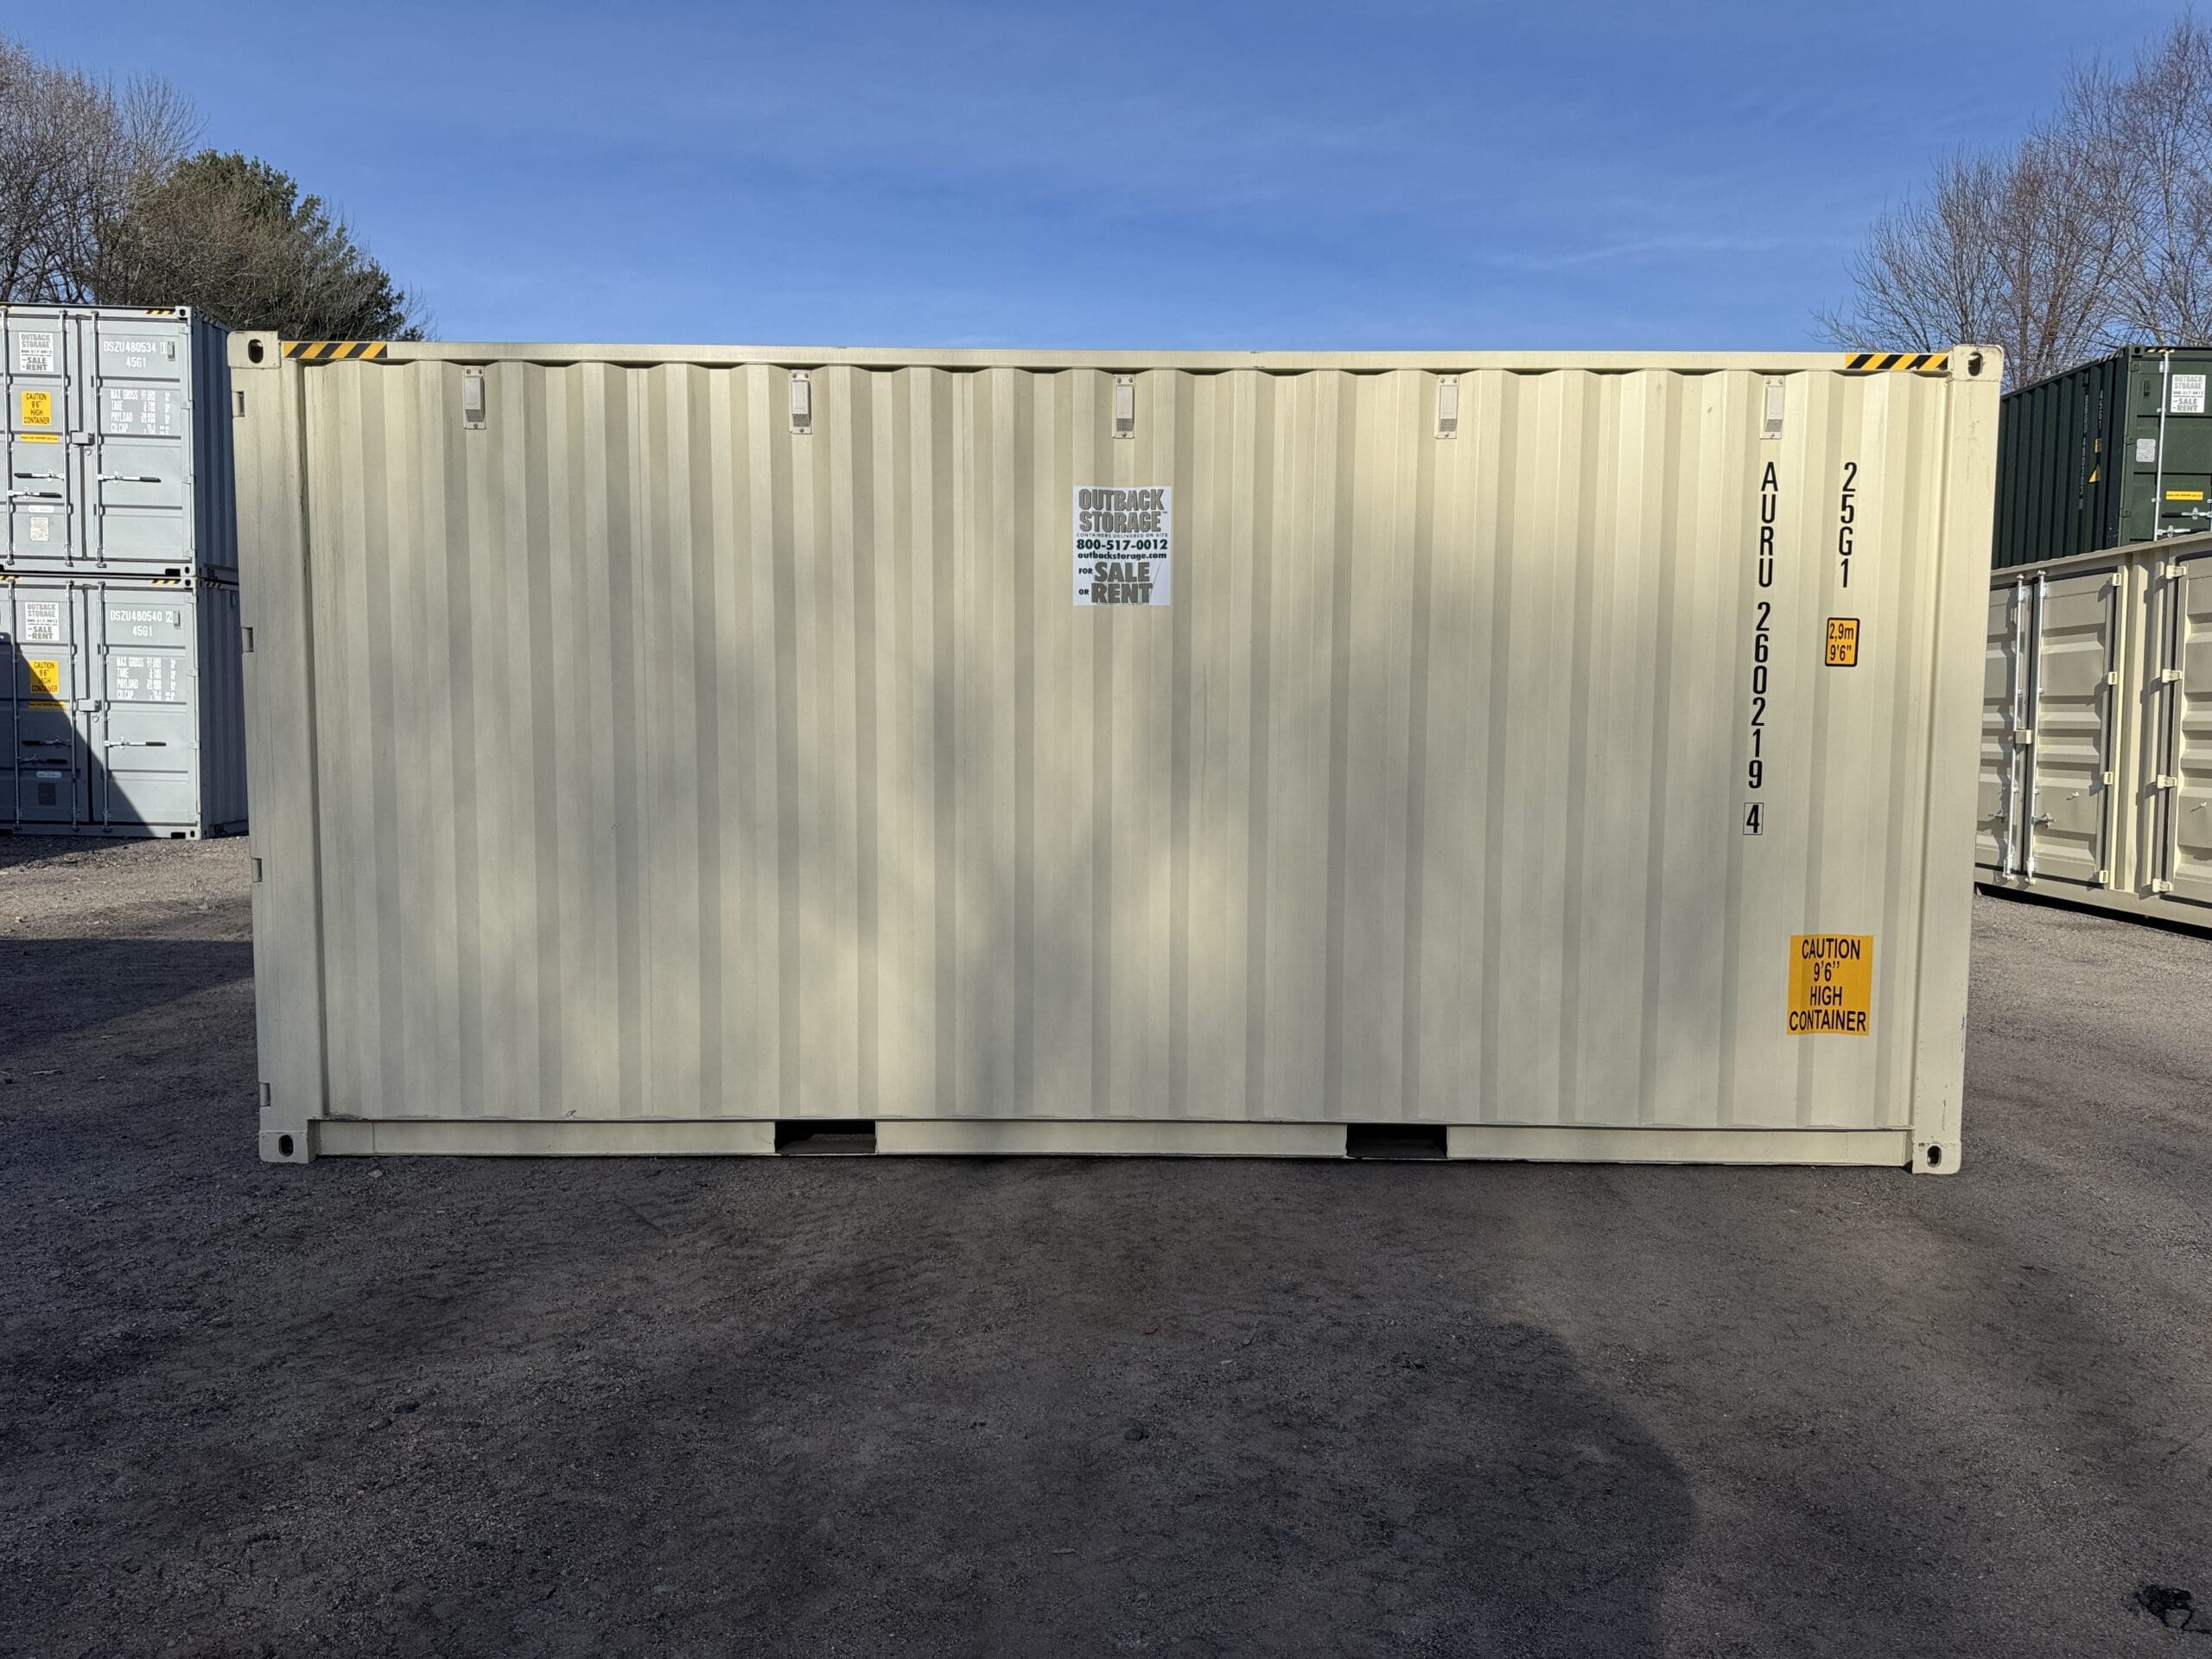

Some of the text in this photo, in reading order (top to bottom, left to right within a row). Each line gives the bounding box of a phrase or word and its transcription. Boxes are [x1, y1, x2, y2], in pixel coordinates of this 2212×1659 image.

[1078, 488, 1165, 512] OUTBACK
[1079, 511, 1161, 533] STORAGE
[1839, 461, 1858, 588] 25G1
[1077, 539, 1168, 550] 800-517-0012
[1077, 550, 1167, 561] outbackstorage.com
[1094, 562, 1150, 582] SALE
[1091, 582, 1154, 603] RENT
[132, 626, 153, 636] 45G1
[1745, 461, 1778, 834] AURU 260219 4
[1802, 938, 1861, 960] CAUTION
[1809, 985, 1843, 1007] HIGH
[1789, 1009, 1866, 1032] CONTAINER
